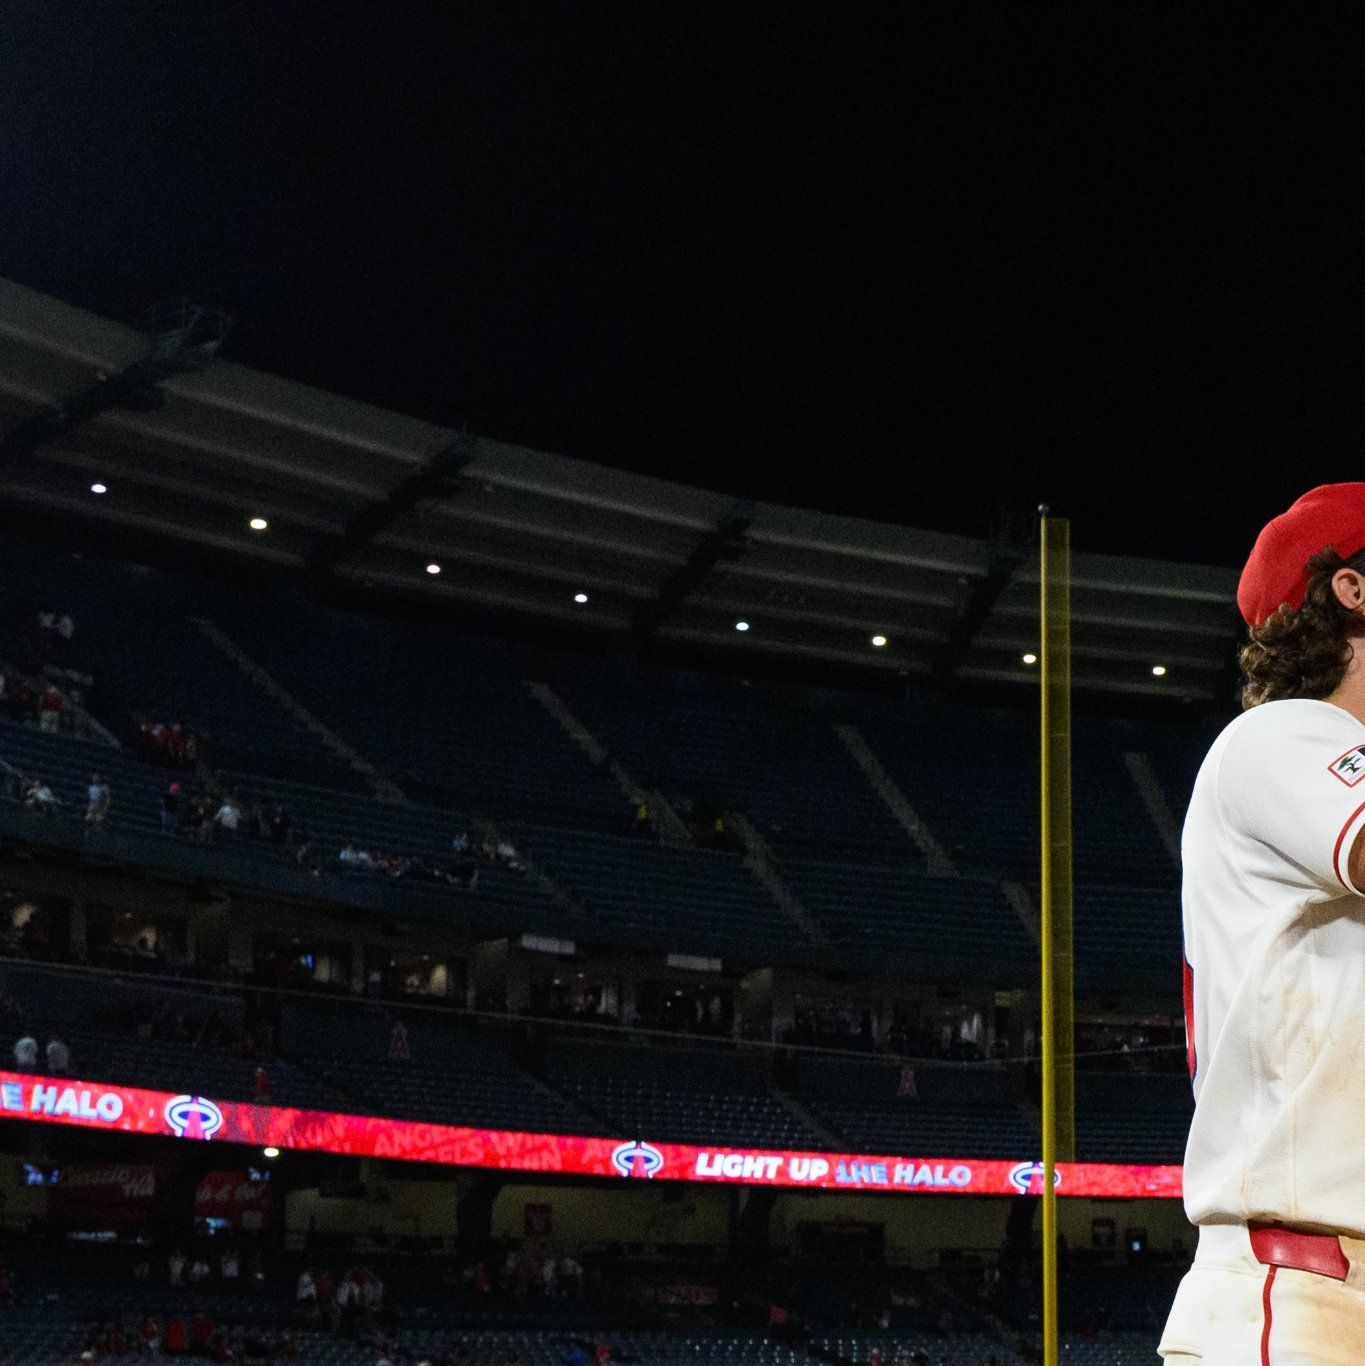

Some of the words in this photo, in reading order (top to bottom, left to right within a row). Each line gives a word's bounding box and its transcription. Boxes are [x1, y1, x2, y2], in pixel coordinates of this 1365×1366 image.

[31, 1084, 123, 1122] HALO
[695, 1152, 783, 1180] LIGHT
[789, 1157, 828, 1181] UP
[893, 1163, 972, 1187] HALO
